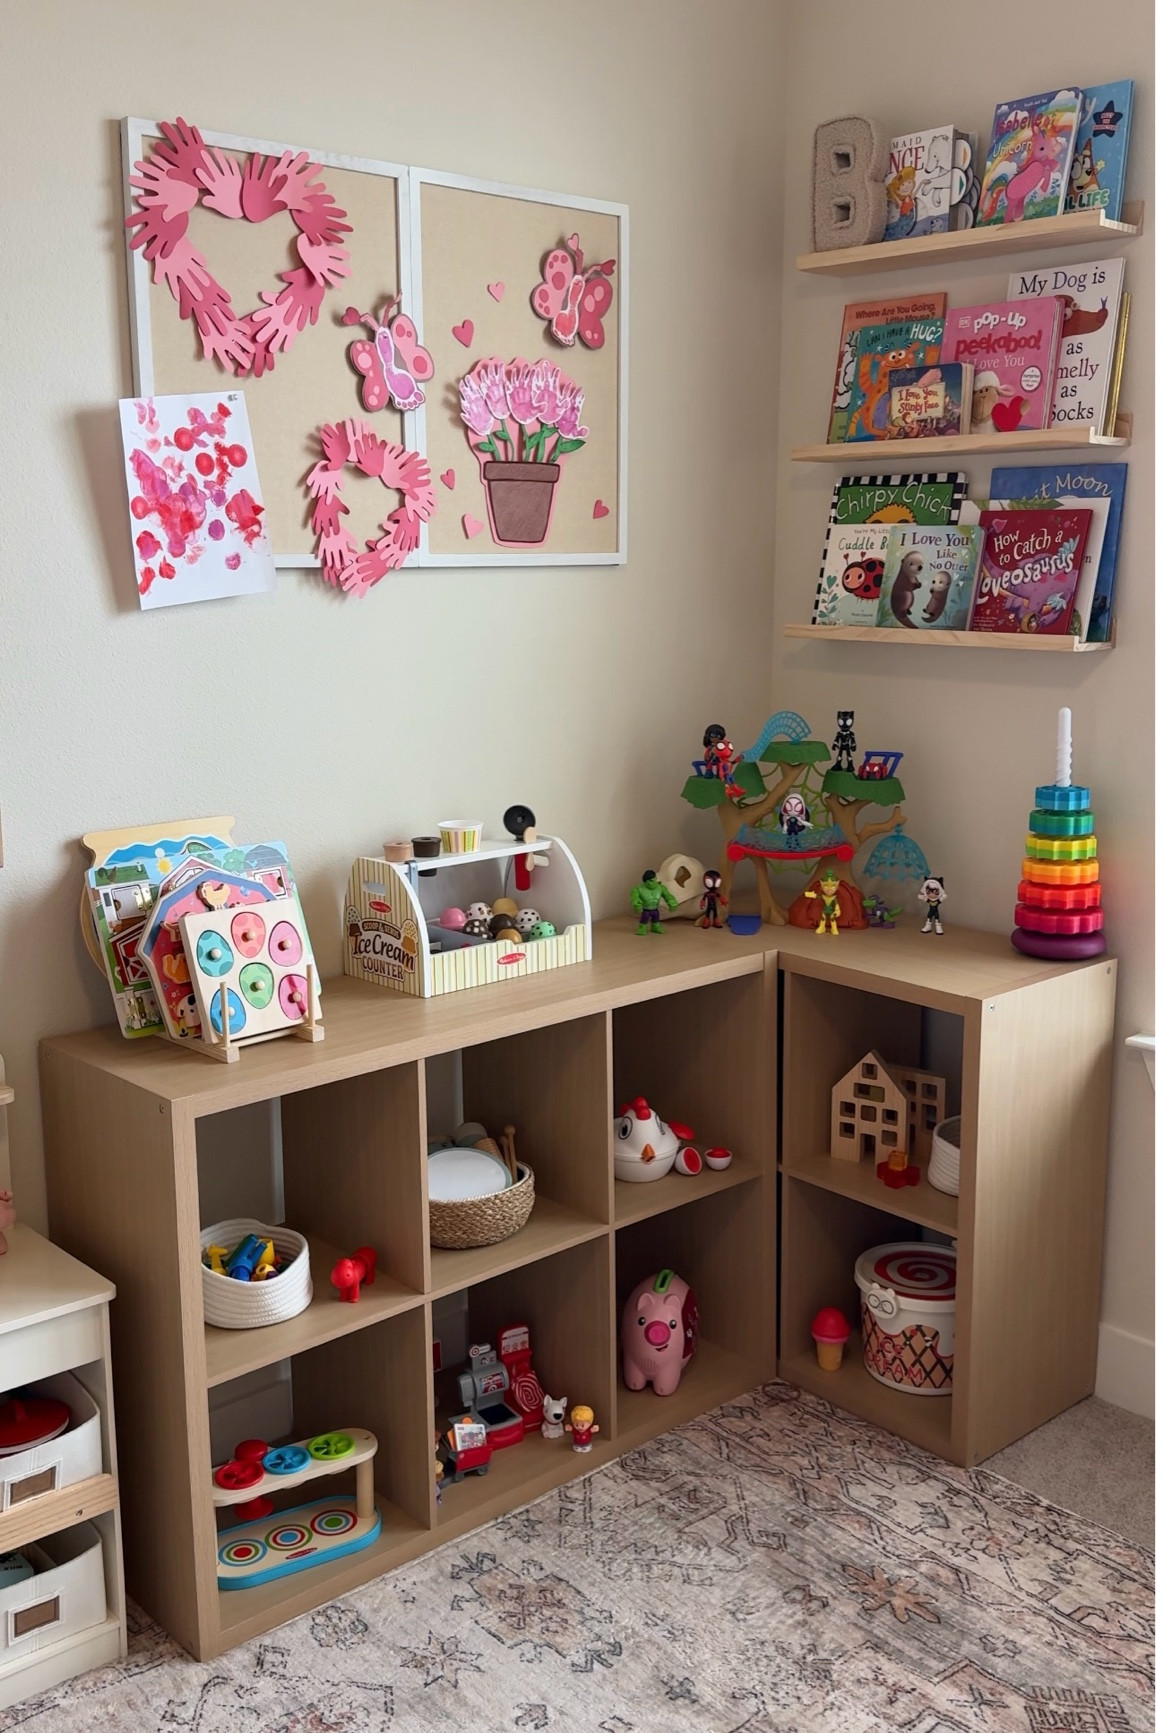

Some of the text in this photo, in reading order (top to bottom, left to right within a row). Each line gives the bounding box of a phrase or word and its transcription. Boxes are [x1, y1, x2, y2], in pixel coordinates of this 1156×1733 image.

[892, 136, 922, 149] MAID
[993, 140, 1032, 158] Unicorn
[888, 146, 925, 175] NCE
[1078, 189, 1110, 208] LIFE
[1018, 266, 1106, 296] My Dog is
[856, 309, 880, 320] Where
[882, 308, 895, 317] Are
[897, 305, 910, 314] You
[866, 334, 881, 347] CAN
[886, 327, 904, 339] HAVE
[905, 326, 910, 336] A
[910, 323, 943, 343] HUG?
[954, 329, 1042, 362] peekaboo!
[1066, 342, 1083, 355] as
[974, 354, 1025, 370] Love You
[1057, 357, 1100, 381] melly
[898, 389, 904, 402] I
[904, 388, 921, 402] Love
[1060, 385, 1078, 398] as
[898, 400, 940, 415] Stinky Face
[1056, 473, 1113, 496] Moon
[836, 481, 952, 521] Chirpy Chick
[838, 535, 875, 551] Cuddle
[900, 532, 969, 547] I Love You
[993, 529, 1020, 553] How
[998, 528, 1063, 566] to Catch a
[936, 549, 957, 559] Like
[929, 560, 969, 572] No Otter
[363, 921, 379, 931] SCOOP
[353, 934, 414, 971] Ice Cream
[362, 956, 404, 980] COUNTER
